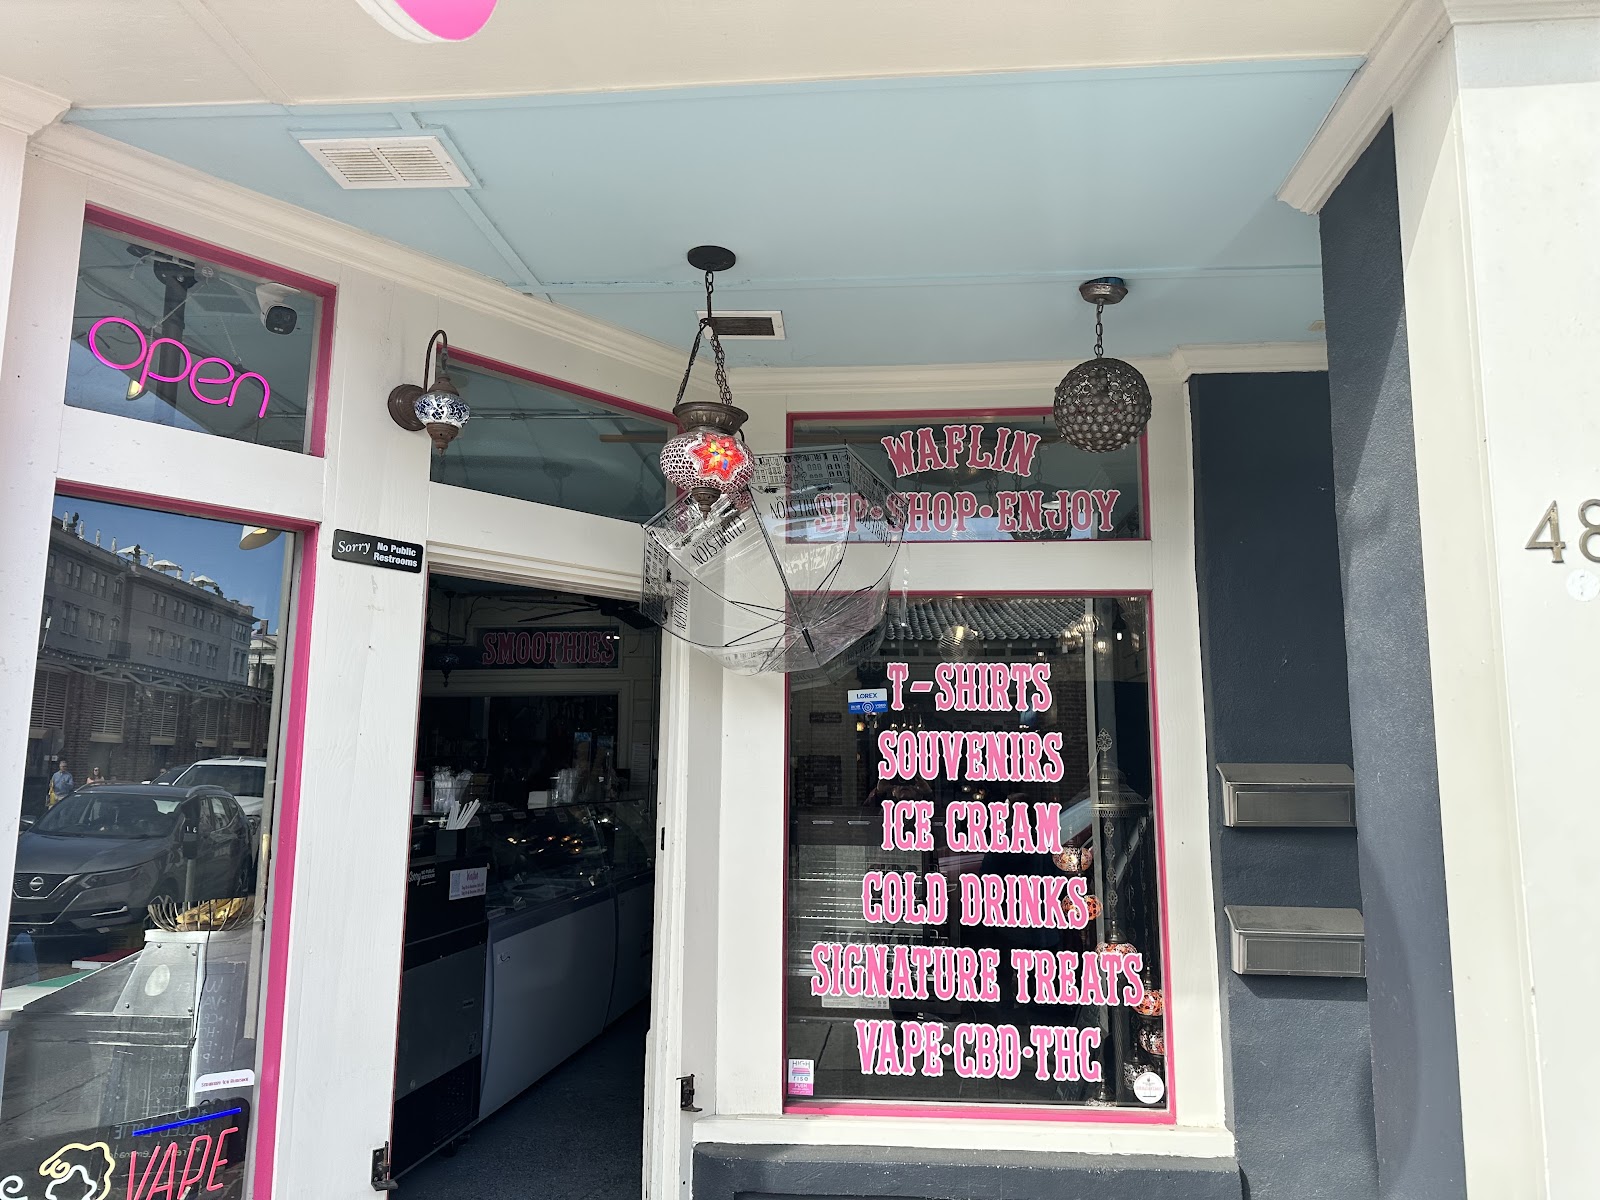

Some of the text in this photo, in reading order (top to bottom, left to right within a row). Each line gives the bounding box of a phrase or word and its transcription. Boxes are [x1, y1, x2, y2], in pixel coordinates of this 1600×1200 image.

[881, 425, 1042, 478] WAFLIN
[337, 540, 417, 557] Sorry No Public
[373, 552, 418, 568] Restrooms
[482, 631, 616, 665] SMOOTHIES
[856, 692, 878, 700] LOREX
[887, 662, 1053, 713] T-SHIRTS
[878, 731, 1065, 782] SOUVENIRS
[881, 800, 1063, 855] ICE CREAM
[861, 872, 1089, 929] COLD DRINKS
[811, 943, 1145, 1007] SIGNATURE TREATS
